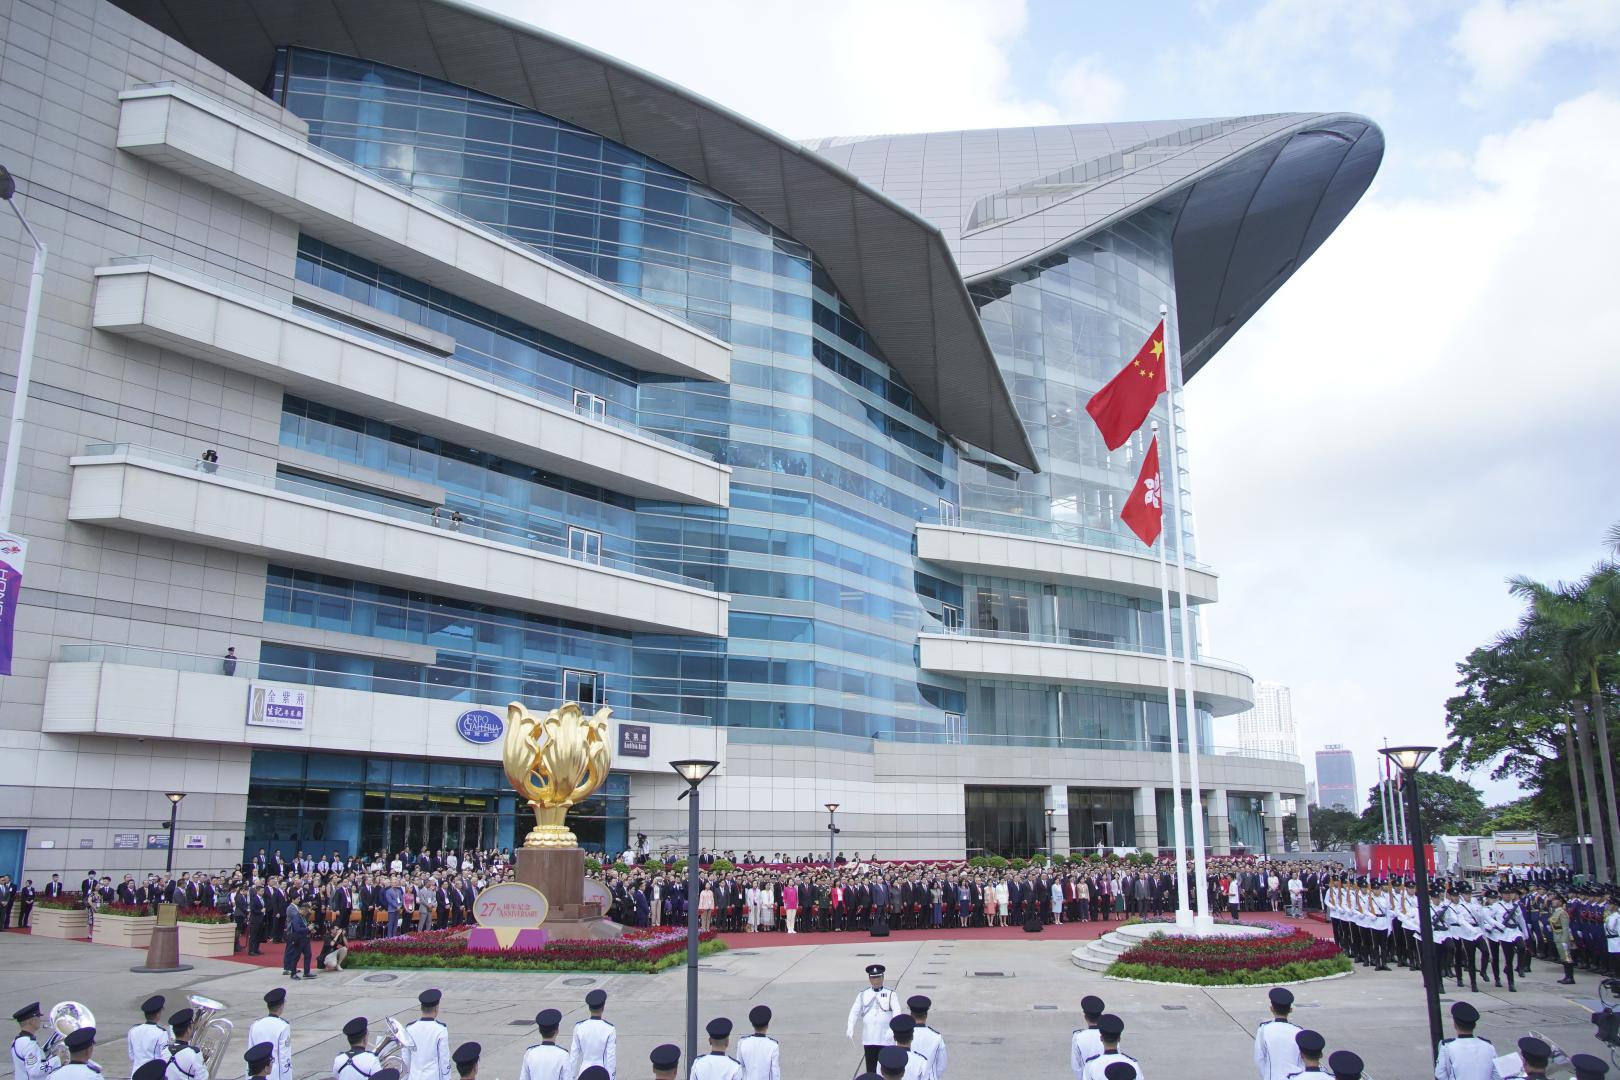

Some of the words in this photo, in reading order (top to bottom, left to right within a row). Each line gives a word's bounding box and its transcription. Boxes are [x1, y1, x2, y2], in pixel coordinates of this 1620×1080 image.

[267, 689, 304, 706] 金紫荊
[466, 714, 489, 724] EXPO
[499, 910, 538, 918] ANNIVERSARY
